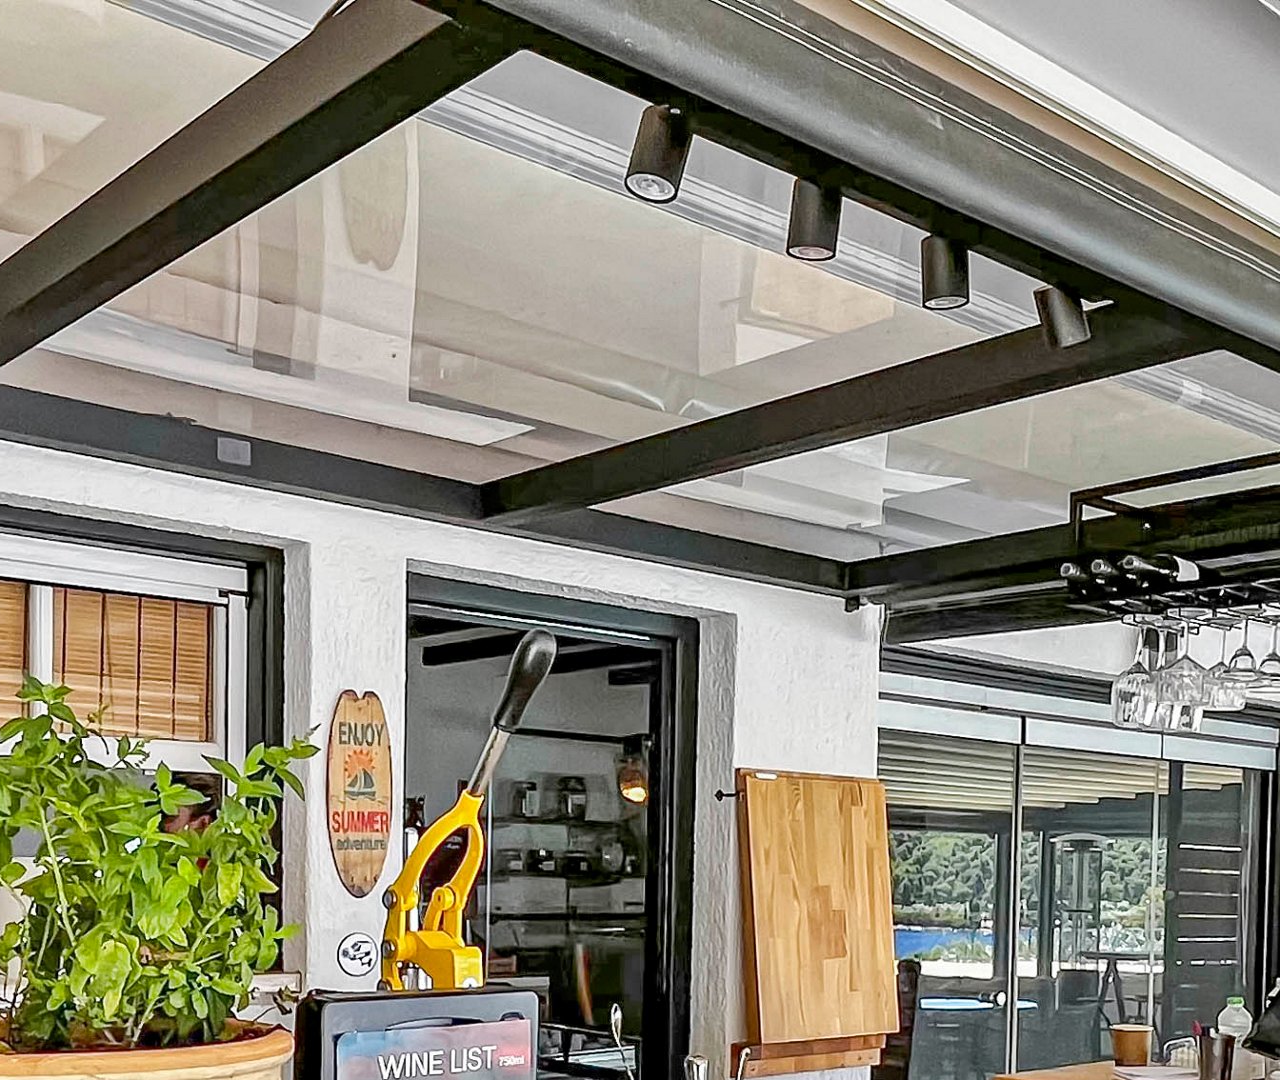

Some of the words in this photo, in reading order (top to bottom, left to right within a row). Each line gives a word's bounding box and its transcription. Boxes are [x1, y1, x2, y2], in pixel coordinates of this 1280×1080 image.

[338, 721, 384, 747] ENJOY
[332, 810, 389, 834] SUMMER
[336, 838, 387, 851] adventure
[377, 1050, 444, 1080] WINE
[450, 1045, 497, 1074] LIST
